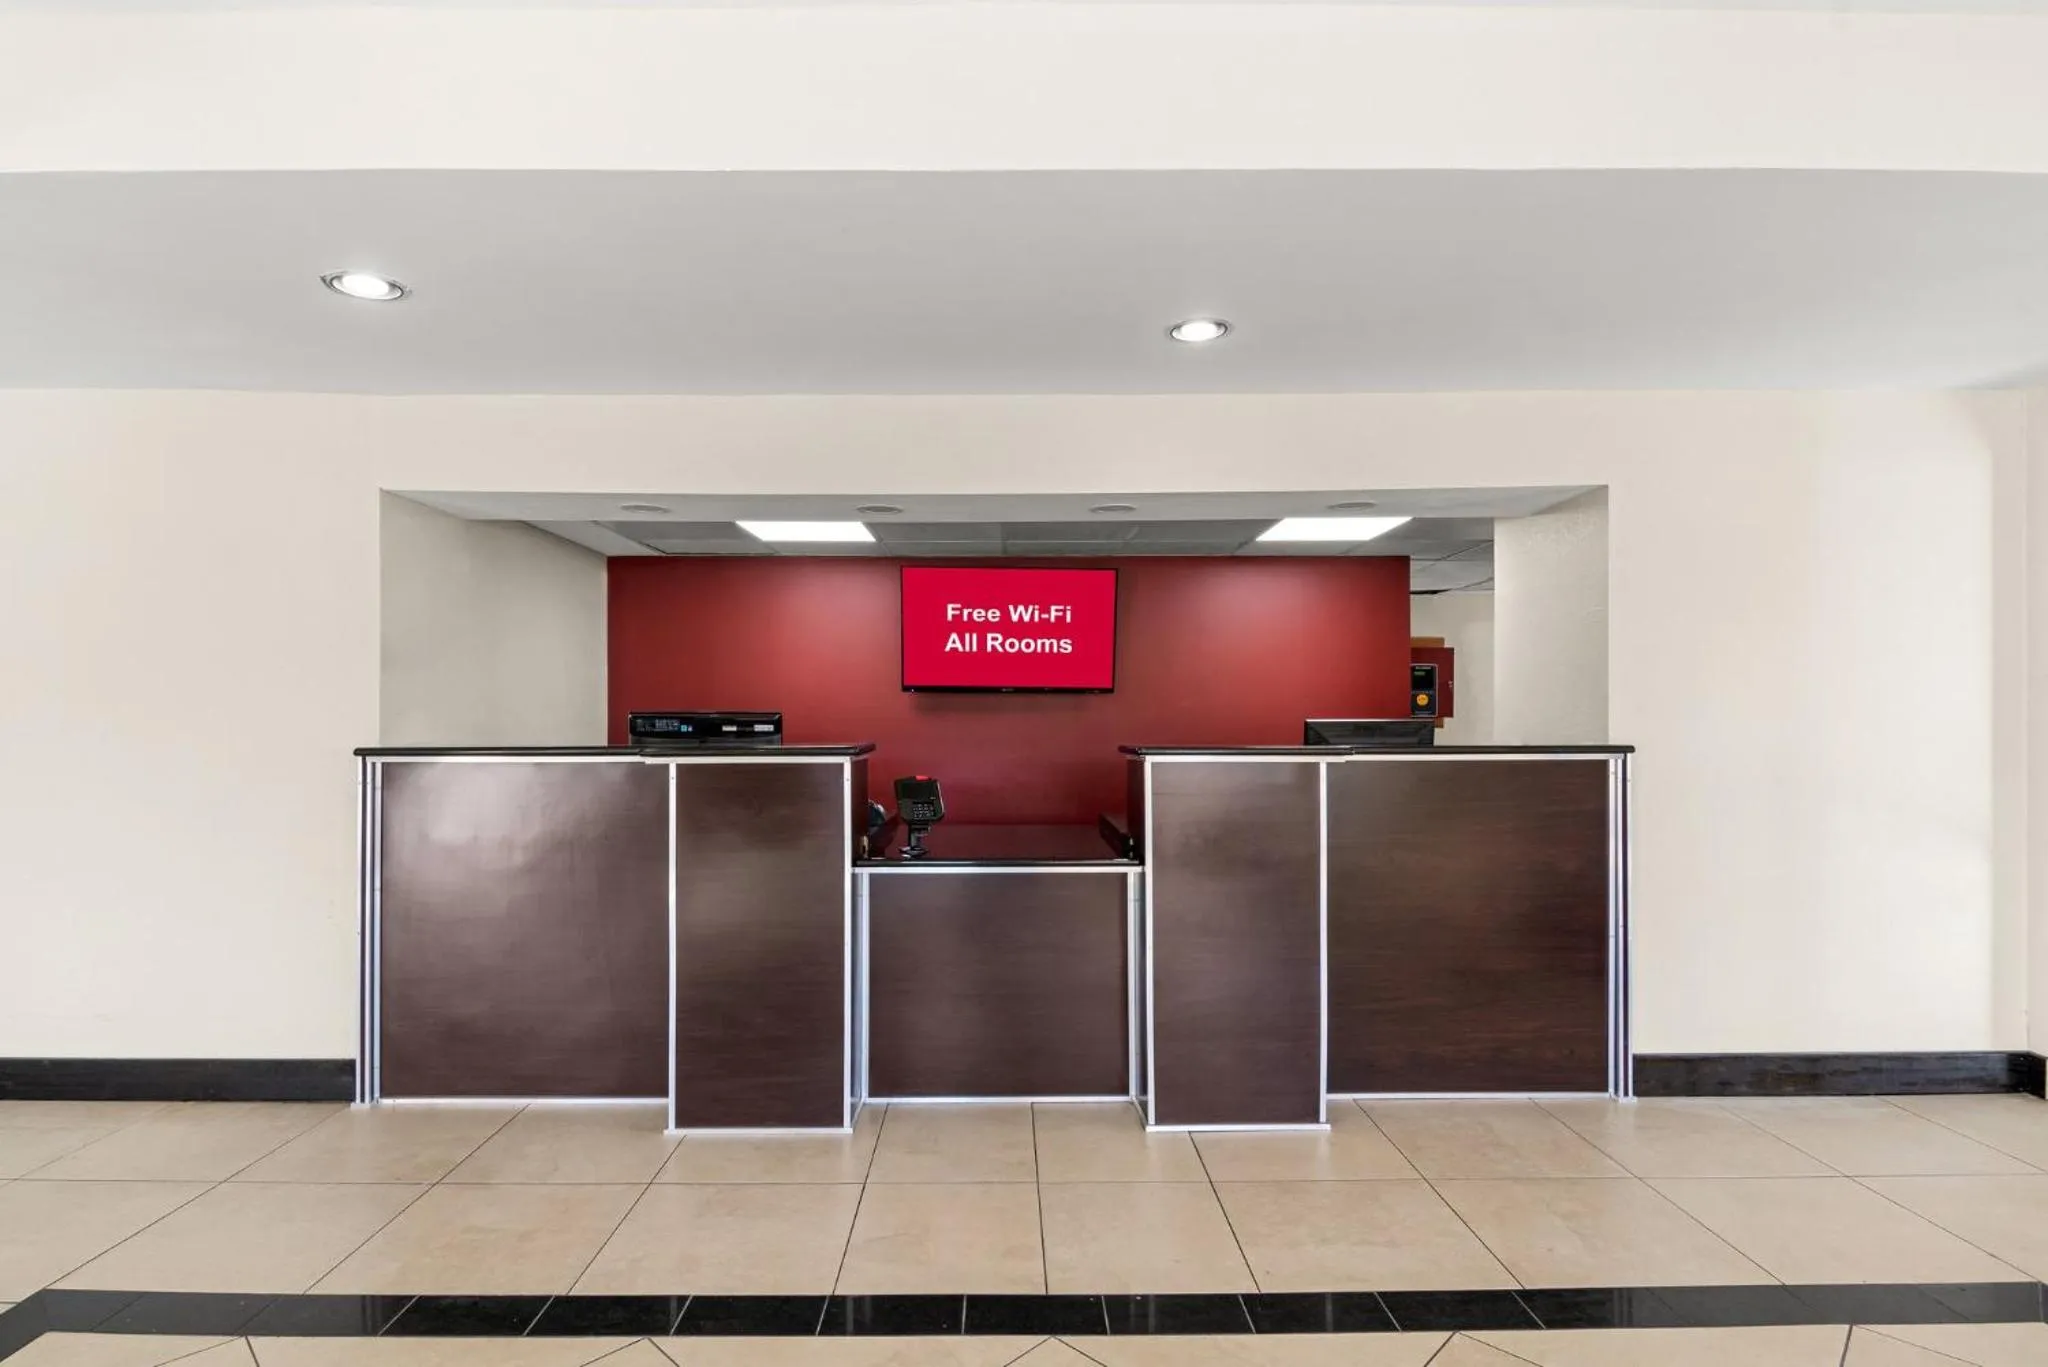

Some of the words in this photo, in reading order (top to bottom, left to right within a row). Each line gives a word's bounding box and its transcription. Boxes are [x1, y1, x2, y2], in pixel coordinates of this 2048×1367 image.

[946, 603, 1001, 622] Free
[1008, 604, 1072, 623] Wi-Fi
[944, 632, 978, 652] All
[986, 632, 1073, 654] Rooms
